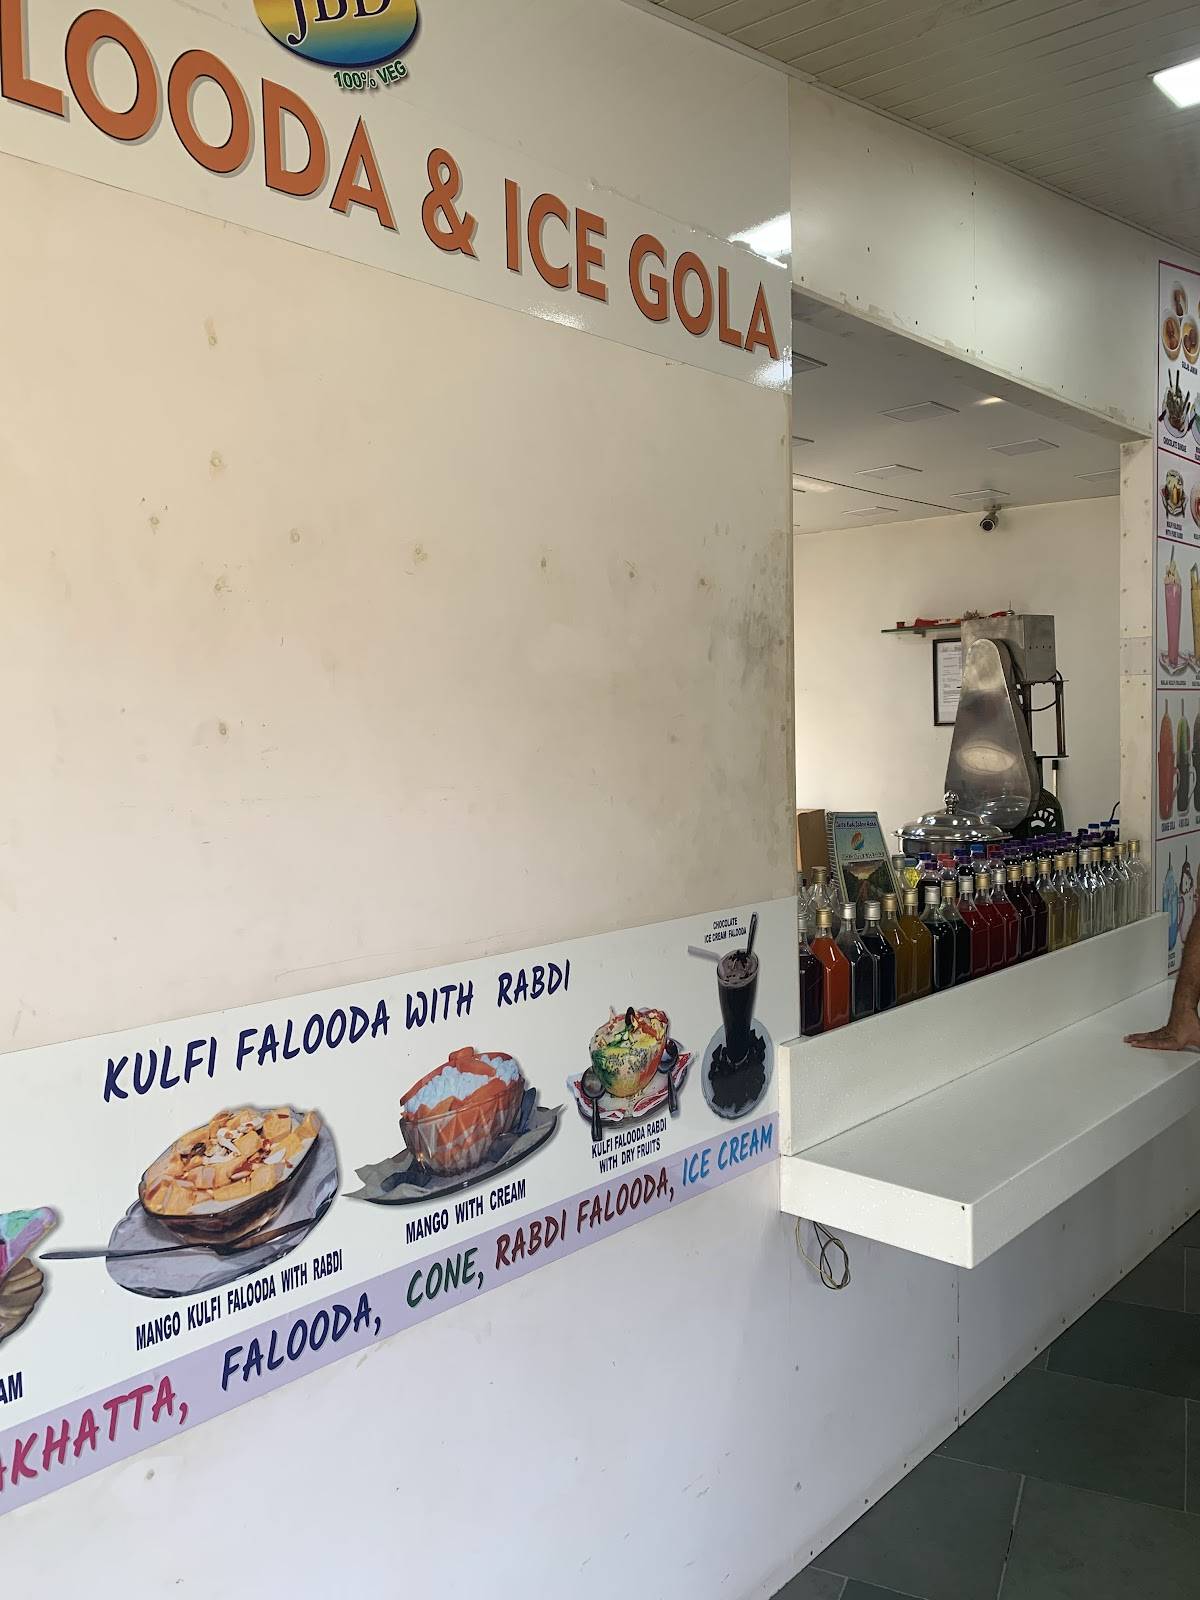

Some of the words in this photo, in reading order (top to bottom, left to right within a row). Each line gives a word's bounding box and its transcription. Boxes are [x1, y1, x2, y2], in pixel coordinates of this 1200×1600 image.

[333, 71, 378, 89] 100%
[376, 60, 407, 84] VEG
[0, 0, 397, 230] LOODA
[422, 147, 478, 257] &
[504, 178, 607, 302] ICE
[629, 233, 780, 360] GOLA
[712, 930, 727, 942] CREAM
[728, 927, 746, 938] FALOODA
[713, 917, 738, 929] CHOCOLATE
[103, 1036, 218, 1103] KULFI
[236, 999, 391, 1072] FALOODA
[405, 979, 474, 1030] WITH
[497, 958, 570, 1008] RABDI
[591, 1138, 613, 1159] KULFI
[614, 1126, 646, 1150] FALOODA
[647, 1117, 667, 1137] RABDI
[599, 1154, 618, 1174] WITH
[621, 1147, 635, 1165] DRY
[637, 1137, 660, 1159] FRUITS
[405, 1208, 449, 1245] MANGO
[454, 1194, 484, 1225] WITH
[489, 1178, 527, 1211] CREAM
[221, 1291, 381, 1392] FALOODA,
[405, 1246, 484, 1309] CONE,
[495, 1208, 567, 1271] RABDI
[576, 1166, 675, 1234] FALOODA,
[682, 1147, 712, 1187] ICE
[717, 1122, 773, 1171] CREAM
[135, 1310, 181, 1351] MANGO
[187, 1295, 221, 1331] KULFI
[227, 1274, 277, 1315] FALOODA
[281, 1262, 308, 1293] WITH
[313, 1248, 343, 1281] RABDI
